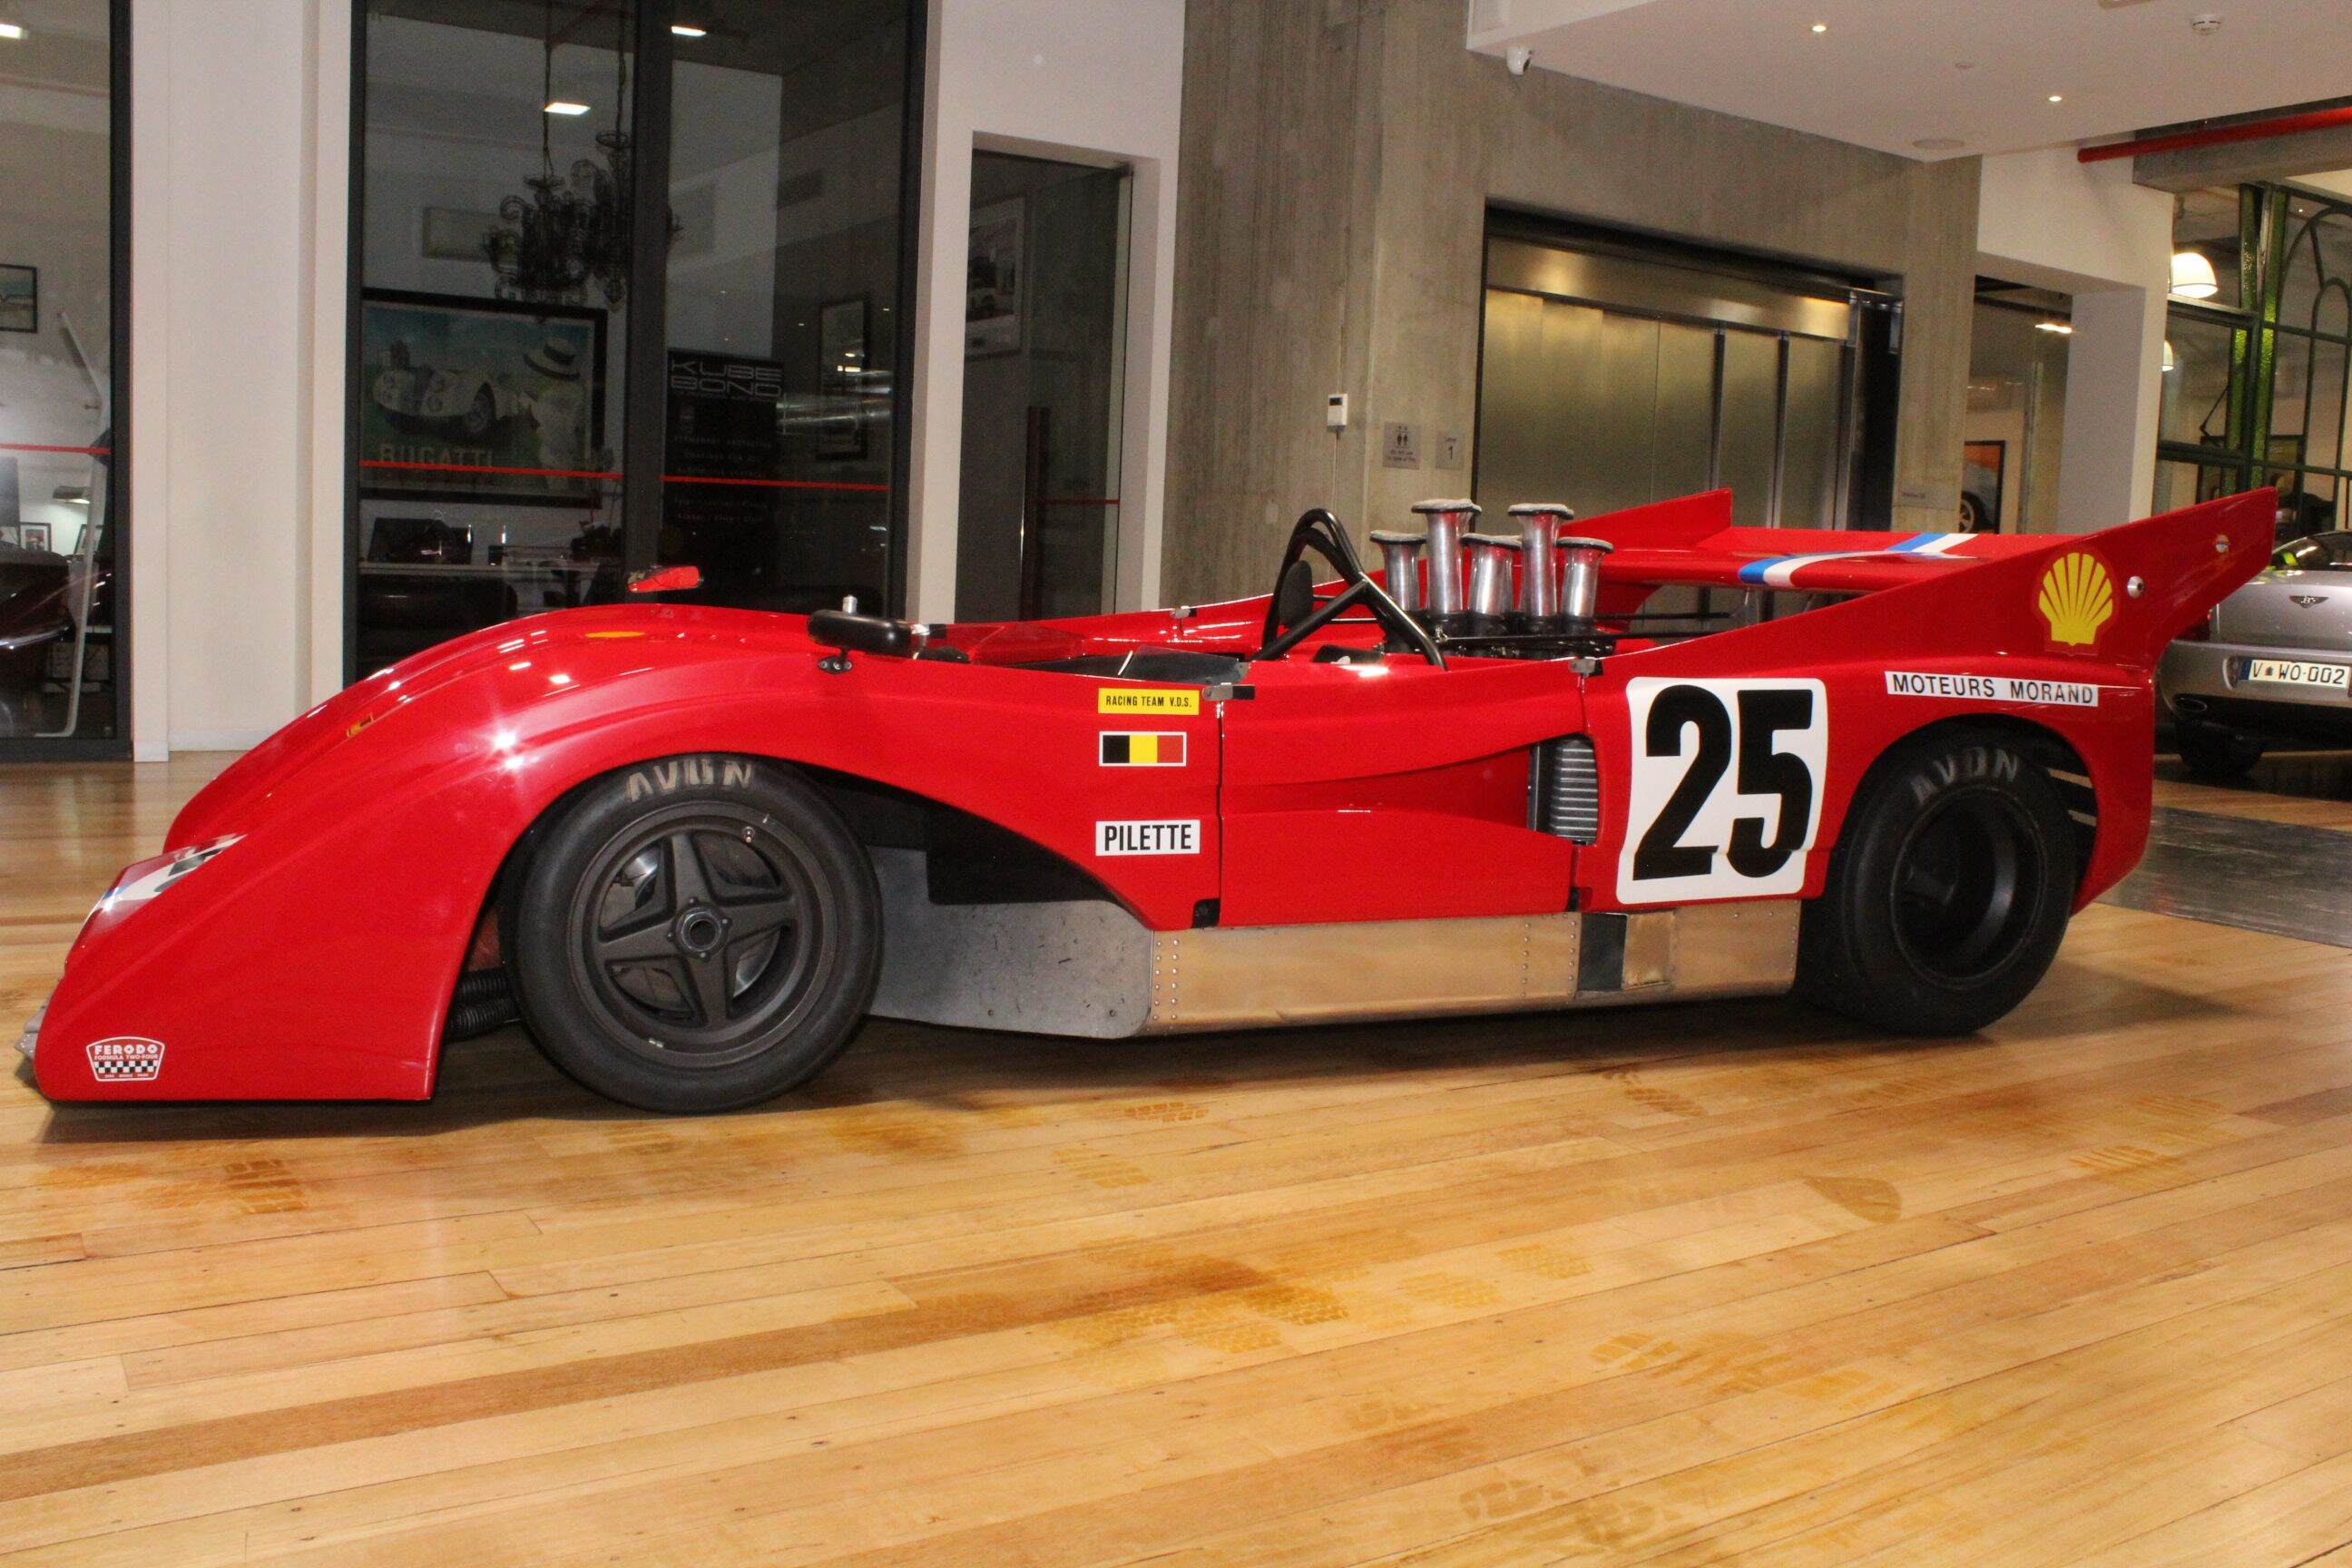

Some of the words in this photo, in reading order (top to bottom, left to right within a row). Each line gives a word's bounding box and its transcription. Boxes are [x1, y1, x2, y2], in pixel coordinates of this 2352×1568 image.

[671, 359, 781, 381] KUBE
[671, 375, 781, 397] BOND
[1893, 674, 1995, 697] MOTEURS
[2010, 681, 2093, 704] MORAND
[1106, 696, 1138, 706] RACING
[1142, 697, 1164, 707] TEAM
[1632, 684, 1813, 881] 25
[1104, 824, 1191, 851] PILETTE
[94, 1044, 158, 1055] FERODO
